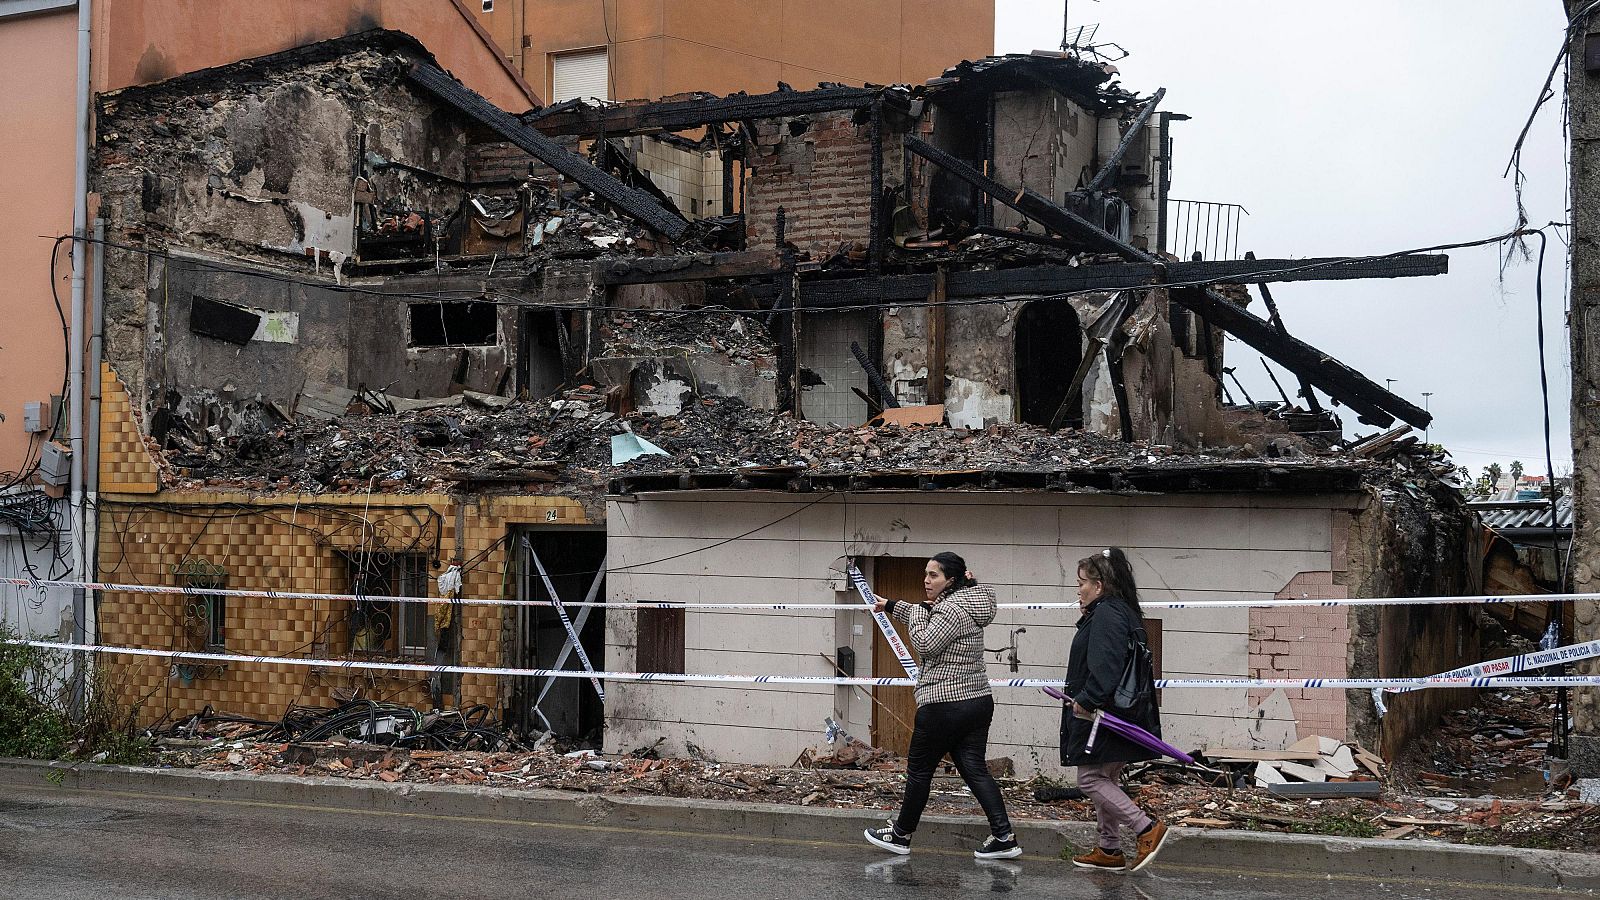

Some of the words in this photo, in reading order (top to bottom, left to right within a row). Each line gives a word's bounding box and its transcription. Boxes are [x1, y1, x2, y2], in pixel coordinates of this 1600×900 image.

[546, 509, 558, 521] 24
[895, 642, 906, 657] PASAR
[1452, 668, 1473, 679] POLICIA
[1482, 665, 1491, 674] NO
[1491, 661, 1510, 673] PASAR
[1533, 652, 1561, 665] NACIONAL
[1561, 651, 1569, 660] DE
[1569, 646, 1591, 659] POLICIA
